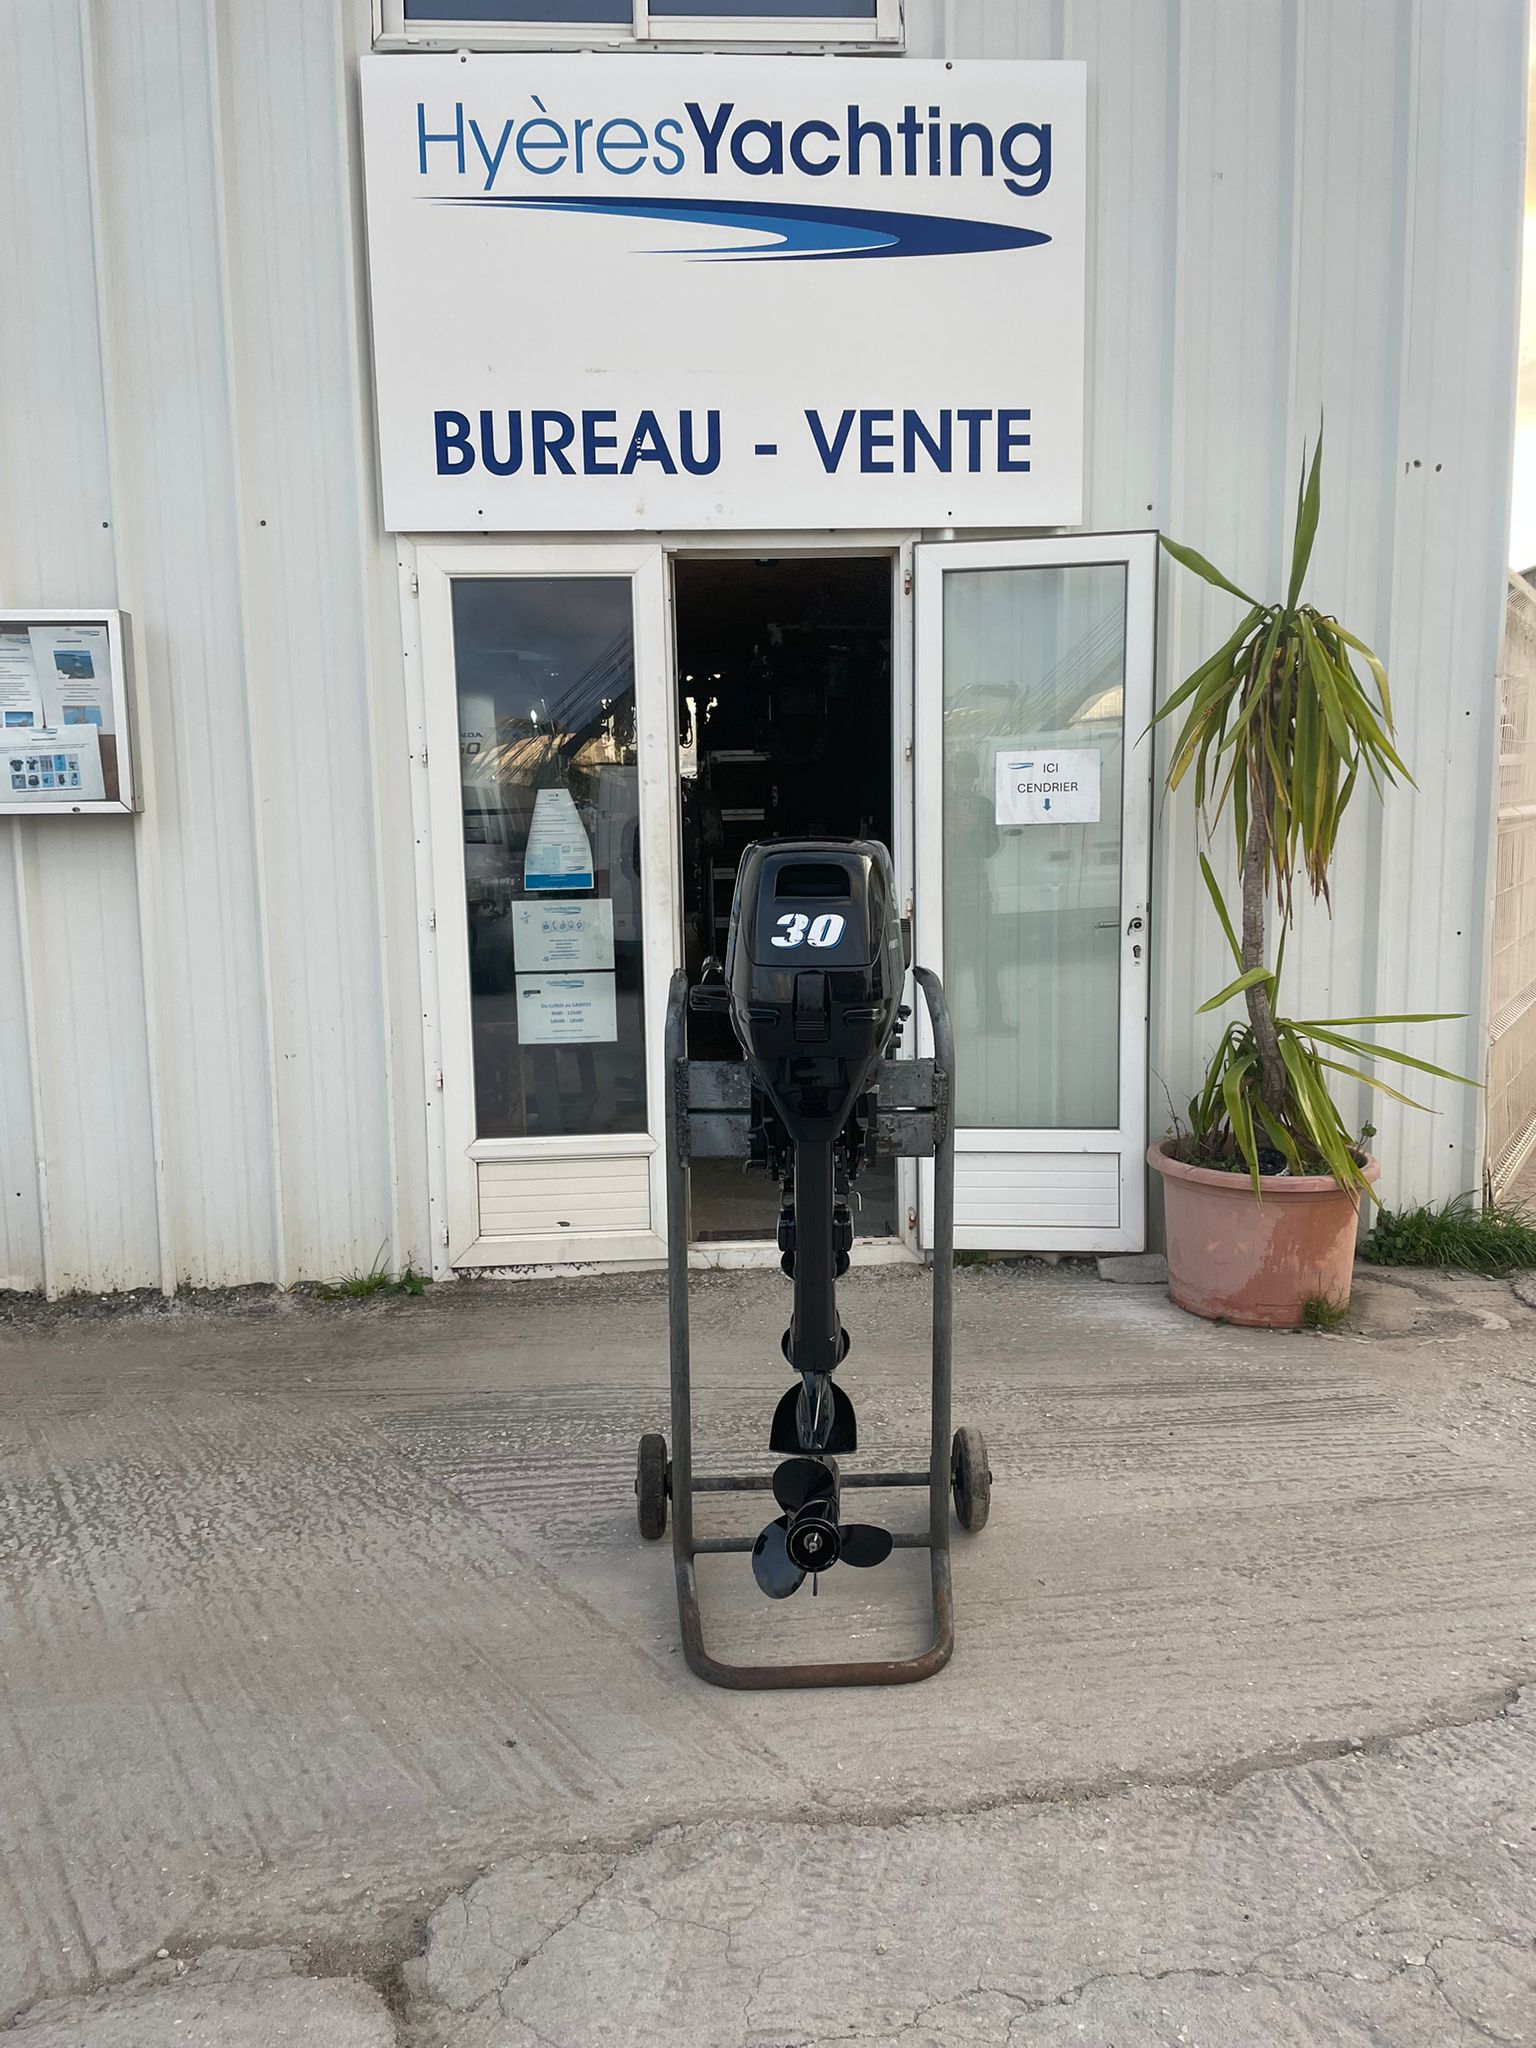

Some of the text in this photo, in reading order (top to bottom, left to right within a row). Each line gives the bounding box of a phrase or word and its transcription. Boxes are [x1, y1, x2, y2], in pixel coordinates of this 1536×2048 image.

[434, 408, 1032, 476] BUREAU - VENTE
[1043, 763, 1059, 773] ICI
[1017, 782, 1079, 793] CENDRIER
[770, 913, 848, 948] 30
